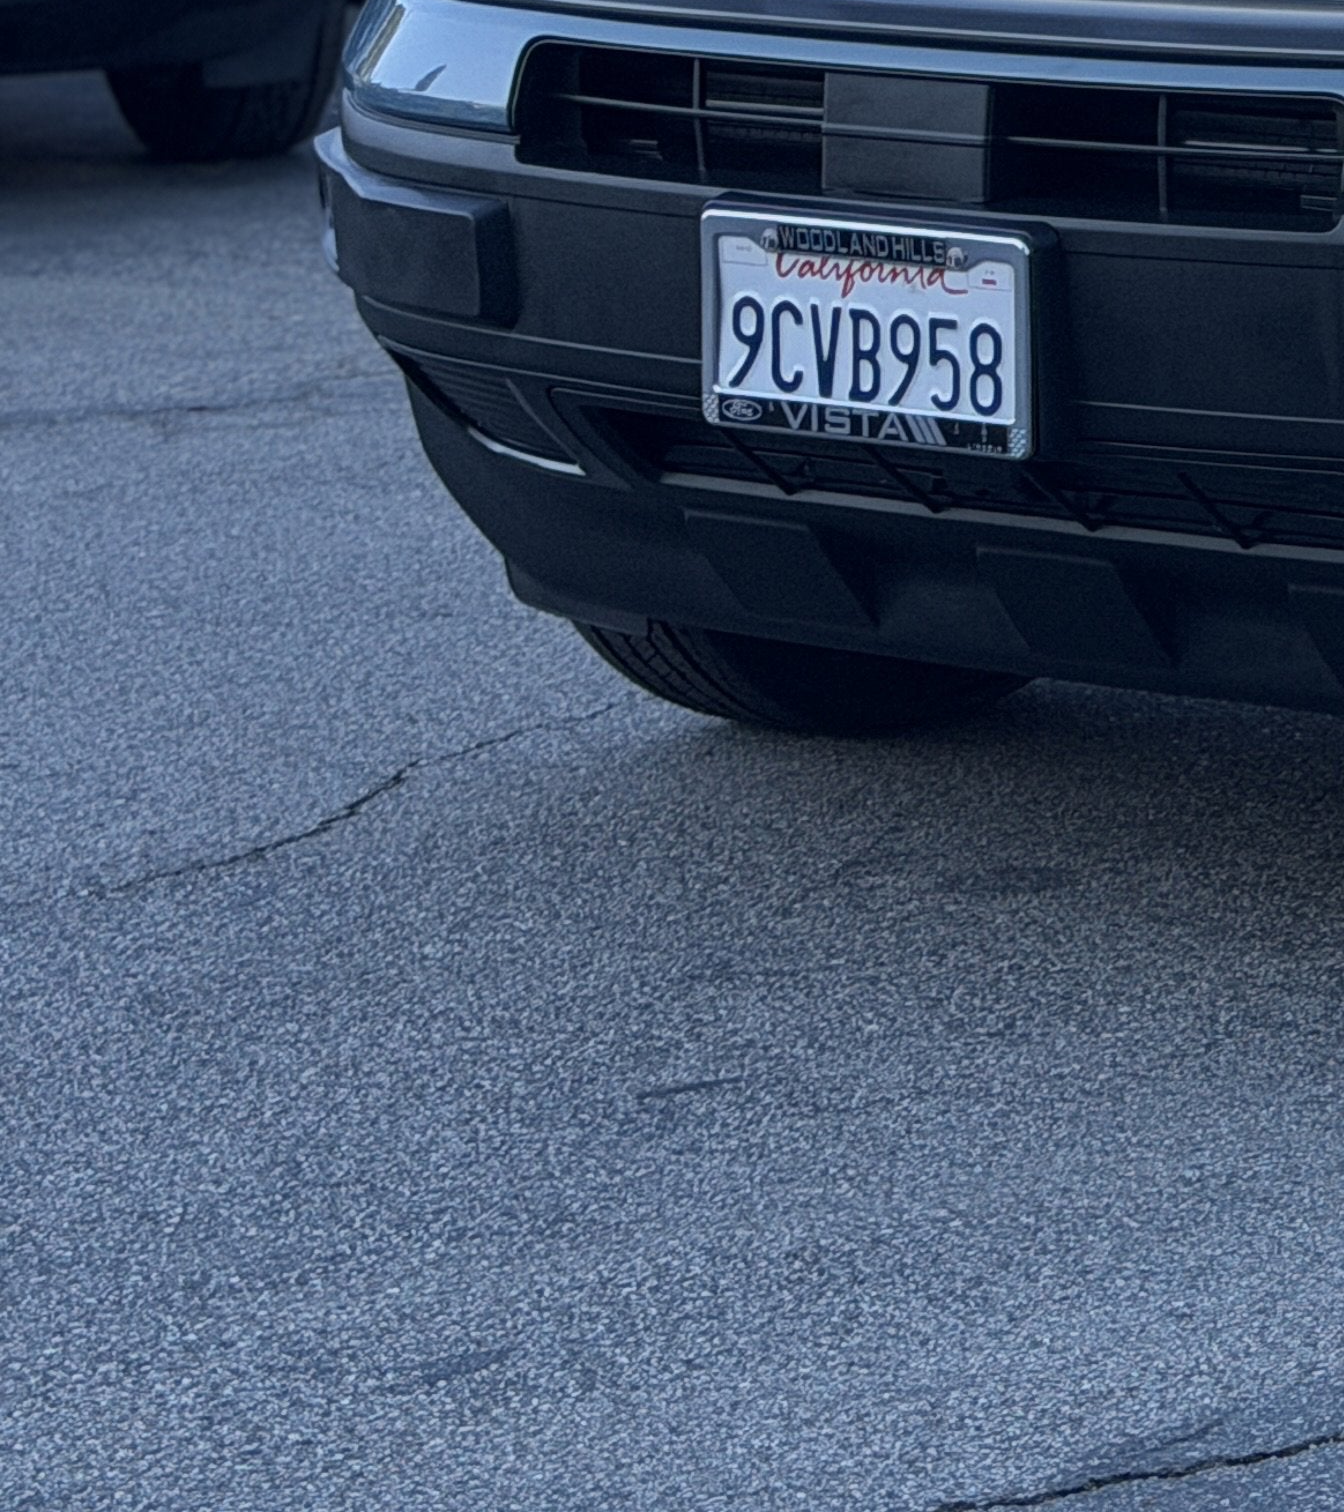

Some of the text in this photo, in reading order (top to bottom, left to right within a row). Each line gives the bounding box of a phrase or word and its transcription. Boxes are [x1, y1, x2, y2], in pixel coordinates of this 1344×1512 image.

[778, 226, 947, 264] WOODLAND HILLS
[775, 252, 968, 299] California
[728, 294, 1003, 417] 9CVB958
[782, 402, 909, 440] VISTA
